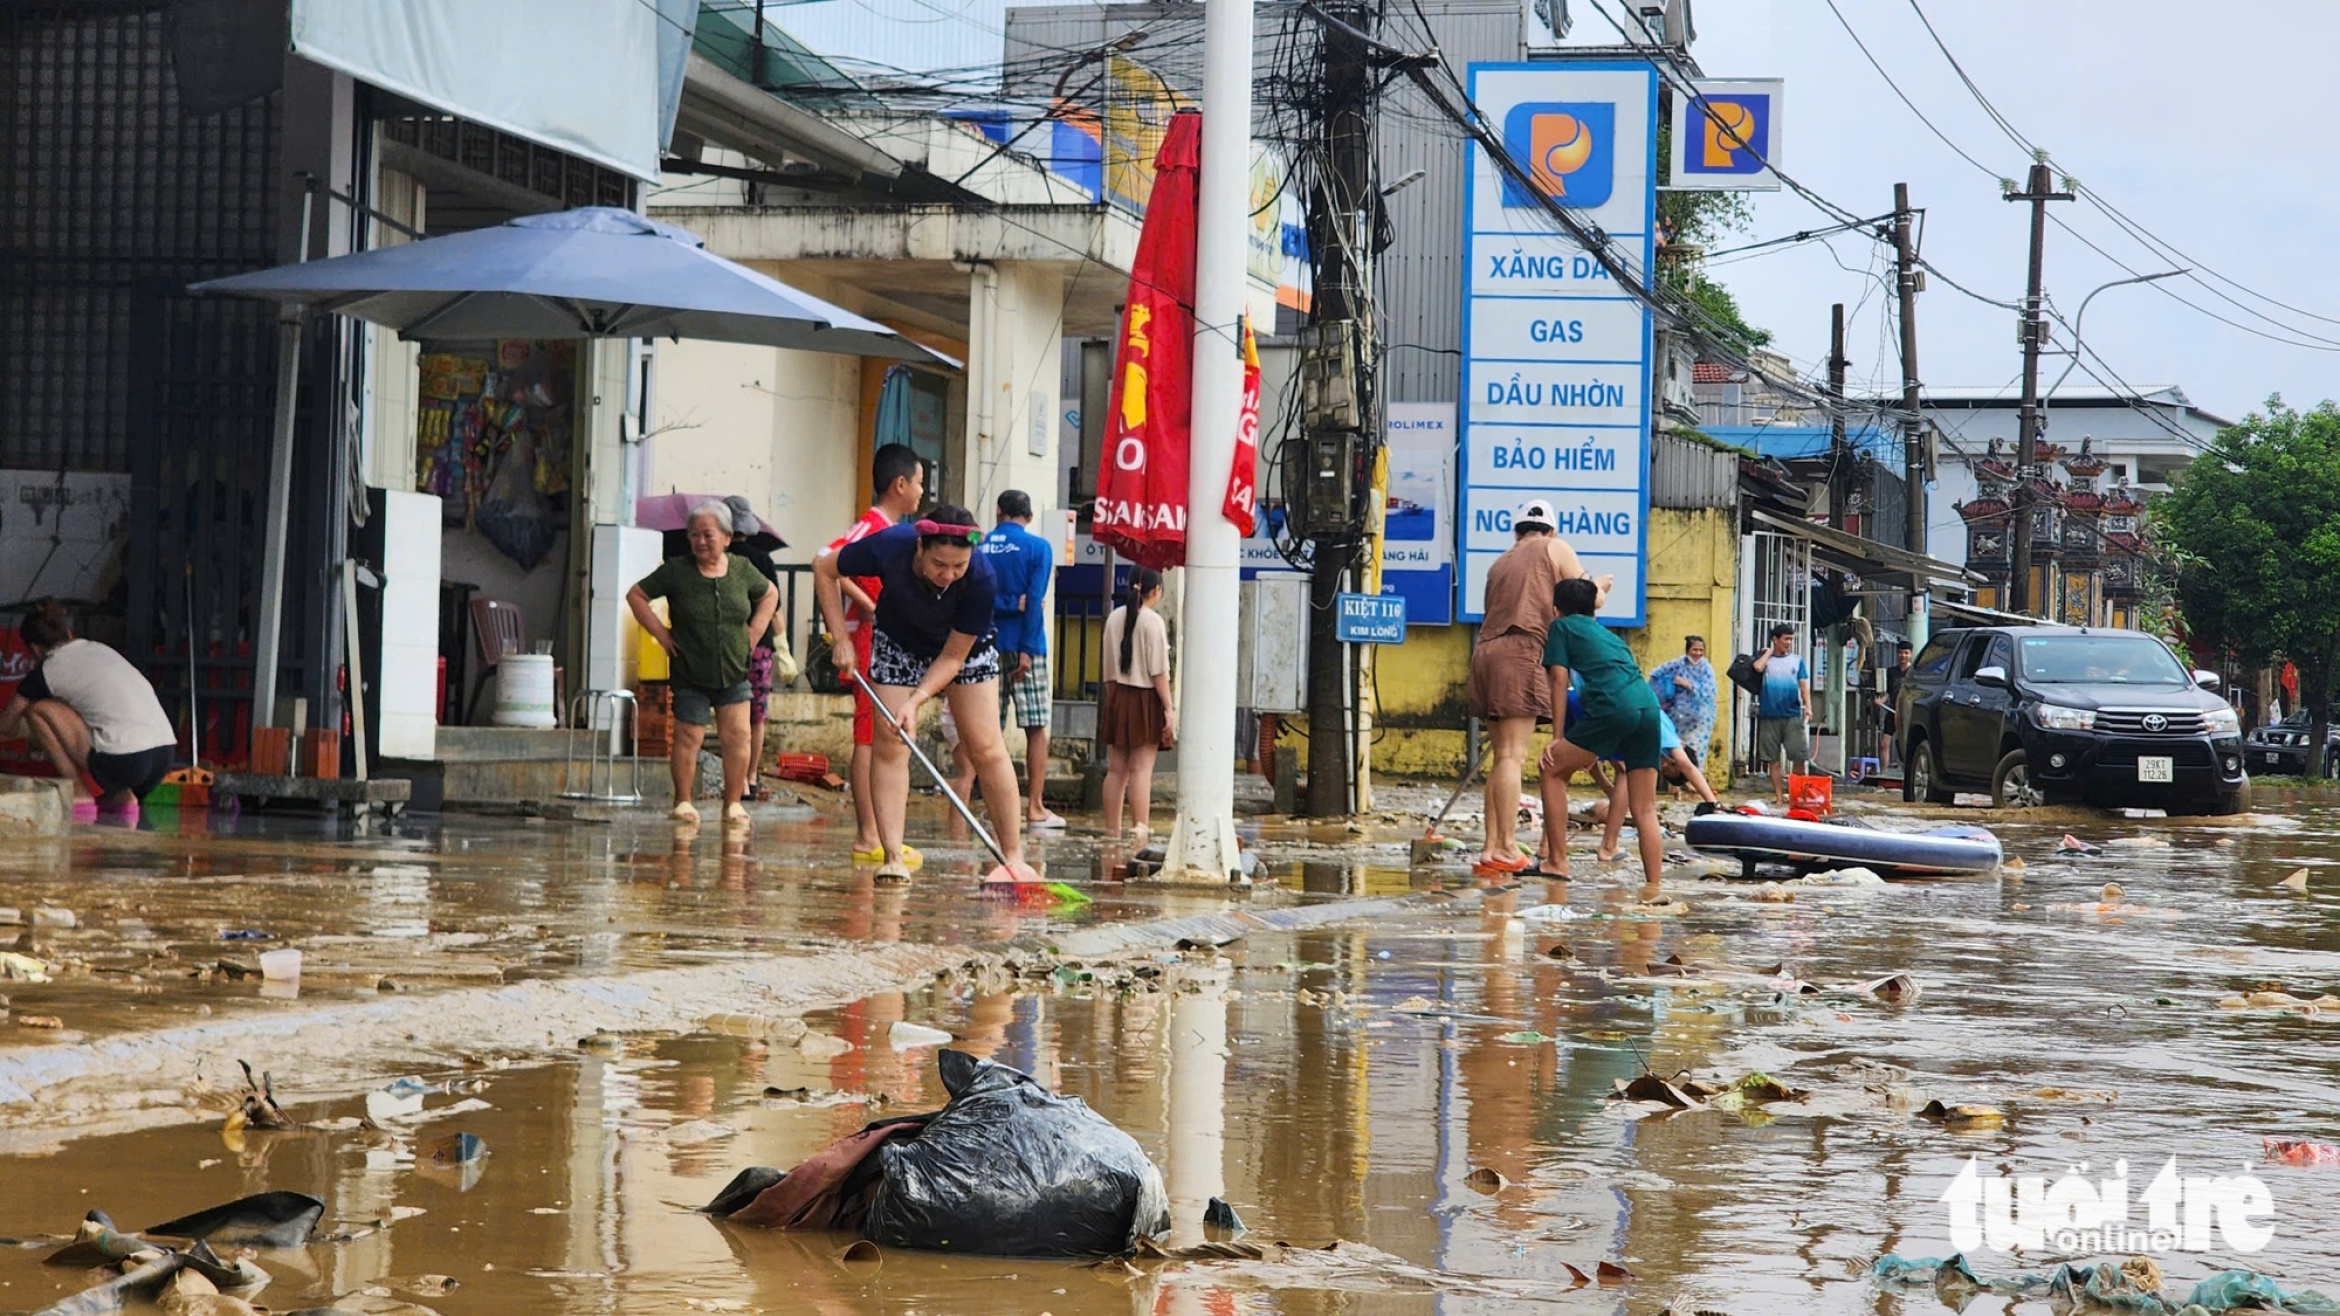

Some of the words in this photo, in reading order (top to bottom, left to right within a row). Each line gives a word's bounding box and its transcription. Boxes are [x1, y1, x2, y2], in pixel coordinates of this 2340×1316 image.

[1490, 248, 1563, 280] XĂNG
[1530, 320, 1583, 343] GAS
[1487, 373, 1542, 406] DẦU
[1551, 379, 1624, 407] NHỜN
[1492, 438, 1546, 470] BẢO
[1554, 436, 1615, 471] HIỂM
[1558, 505, 1630, 535] HÀNG
[1344, 597, 1379, 619] KIỆT
[1382, 601, 1401, 618] 116
[1350, 626, 1369, 636] KIM
[1370, 626, 1398, 637] LONG
